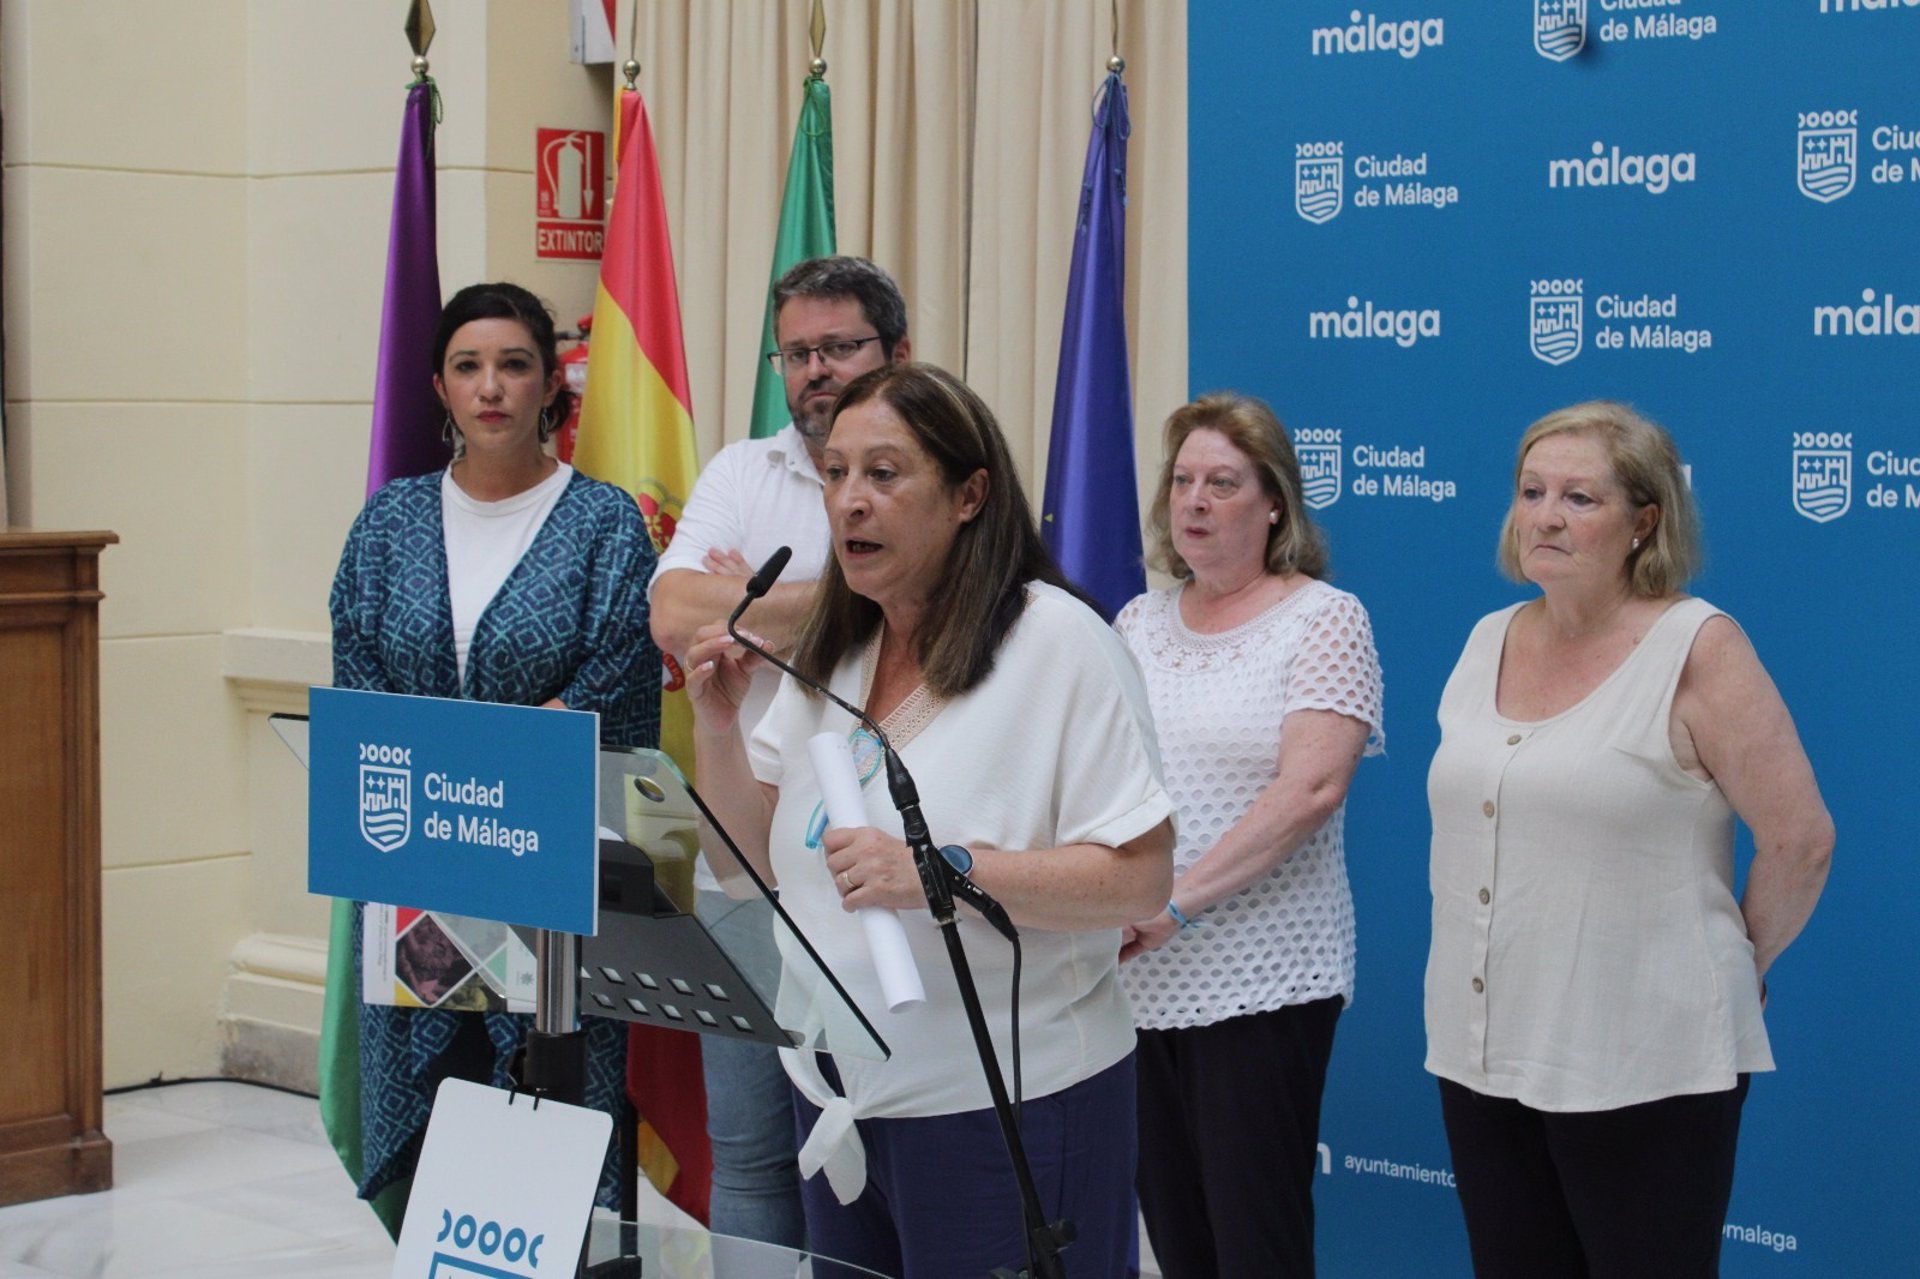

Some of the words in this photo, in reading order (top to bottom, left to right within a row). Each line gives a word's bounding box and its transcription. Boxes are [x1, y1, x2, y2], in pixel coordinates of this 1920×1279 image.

[1600, 18, 1629, 41] de
[1635, 13, 1717, 40] Málaga
[1354, 153, 1427, 178] Ciudad
[1872, 159, 1904, 183] de
[1354, 185, 1381, 207] de
[1386, 183, 1459, 209] Málaga
[538, 228, 603, 253] EXTINTOR
[1596, 294, 1677, 318] Ciudad
[1596, 326, 1625, 348] de
[1631, 324, 1712, 353] Málaga
[1353, 445, 1425, 467] Ciudad
[1353, 474, 1379, 496] de
[1384, 472, 1456, 502] Málaga
[1867, 484, 1898, 507] de
[424, 773, 504, 808] Ciudad
[424, 812, 452, 840] de
[458, 815, 538, 857] Málaga
[1722, 1225, 1797, 1252] malaga
